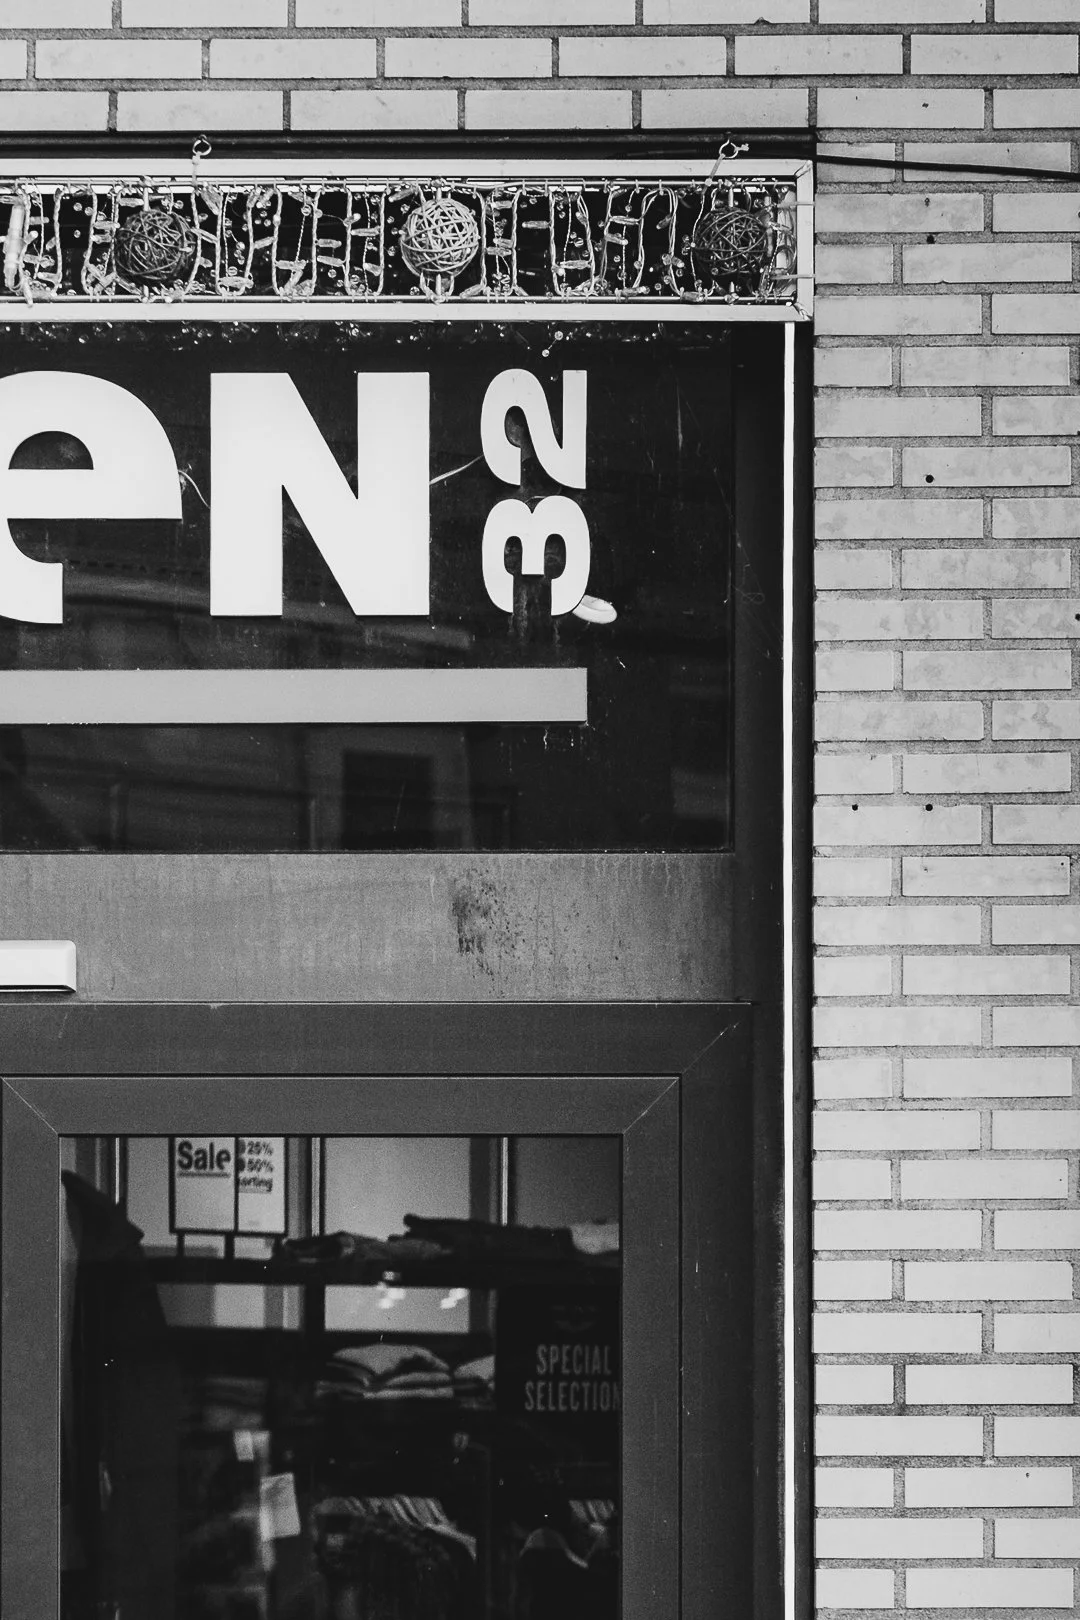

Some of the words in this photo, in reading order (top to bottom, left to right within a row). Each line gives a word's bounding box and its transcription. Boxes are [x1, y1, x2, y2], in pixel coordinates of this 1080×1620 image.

[481, 367, 591, 617] 32
[177, 1140, 231, 1171] Sale
[247, 1141, 273, 1156] 25%
[247, 1158, 274, 1173] 50%
[239, 1177, 273, 1193] orting
[536, 1344, 612, 1375] SPECIAL
